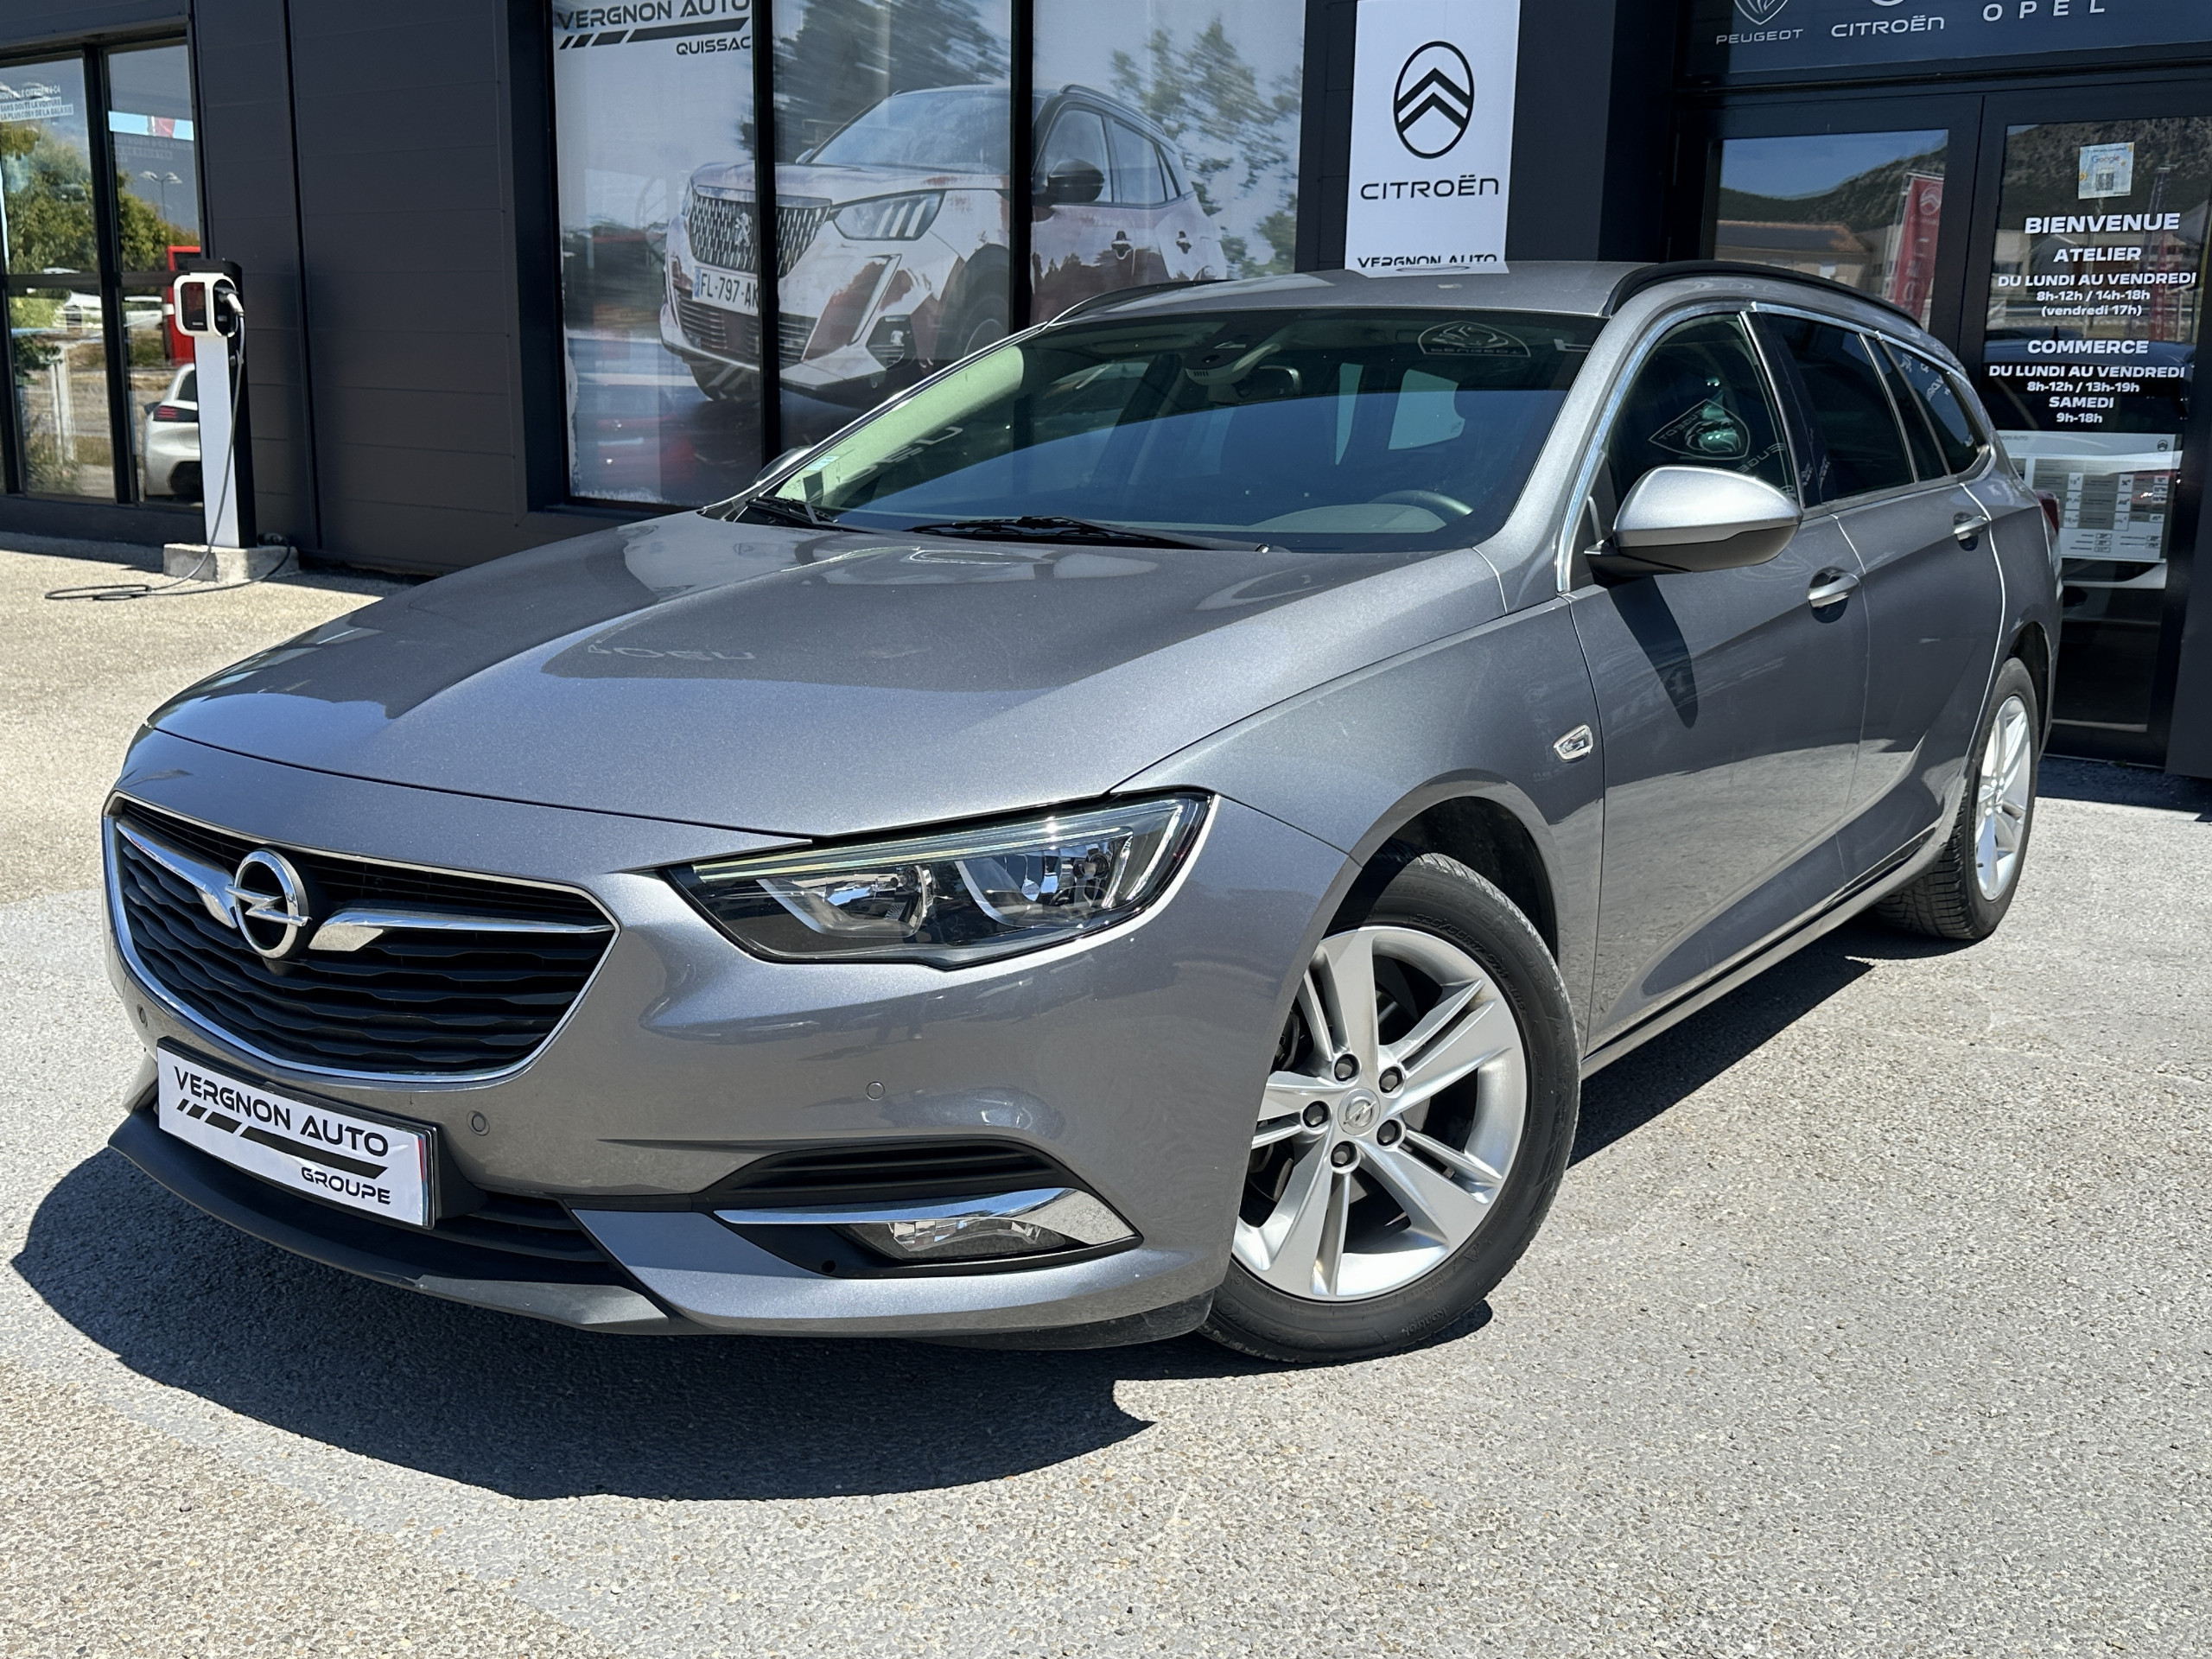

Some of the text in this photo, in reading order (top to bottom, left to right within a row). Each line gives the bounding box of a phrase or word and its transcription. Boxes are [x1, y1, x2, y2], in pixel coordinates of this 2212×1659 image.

[557, 1, 672, 30] VERGNON
[1982, 0, 2106, 22] OPEL
[676, 36, 752, 55] QUISSAC
[1715, 29, 1804, 46] PEUGEOT
[2024, 213, 2181, 234] BIENVENUE
[2052, 246, 2142, 263] ATELIER
[1998, 272, 2197, 287] DU LUNDI AU VENDREDI
[2036, 289, 2152, 302] 8h-12h / 14h-18h
[2041, 305, 2143, 317] (vendredi 17h)
[2026, 340, 2150, 355] COMMERCE
[1988, 365, 2186, 378] DU LUNDI AU VENDREDI
[2026, 381, 2140, 393] 8h-12h / 13h-19h
[2048, 396, 2115, 409] SAMEDI
[2056, 412, 2104, 423] 9h-18h
[173, 1065, 389, 1157] VERGNON AUTO
[301, 1166, 391, 1205] GROUPE
